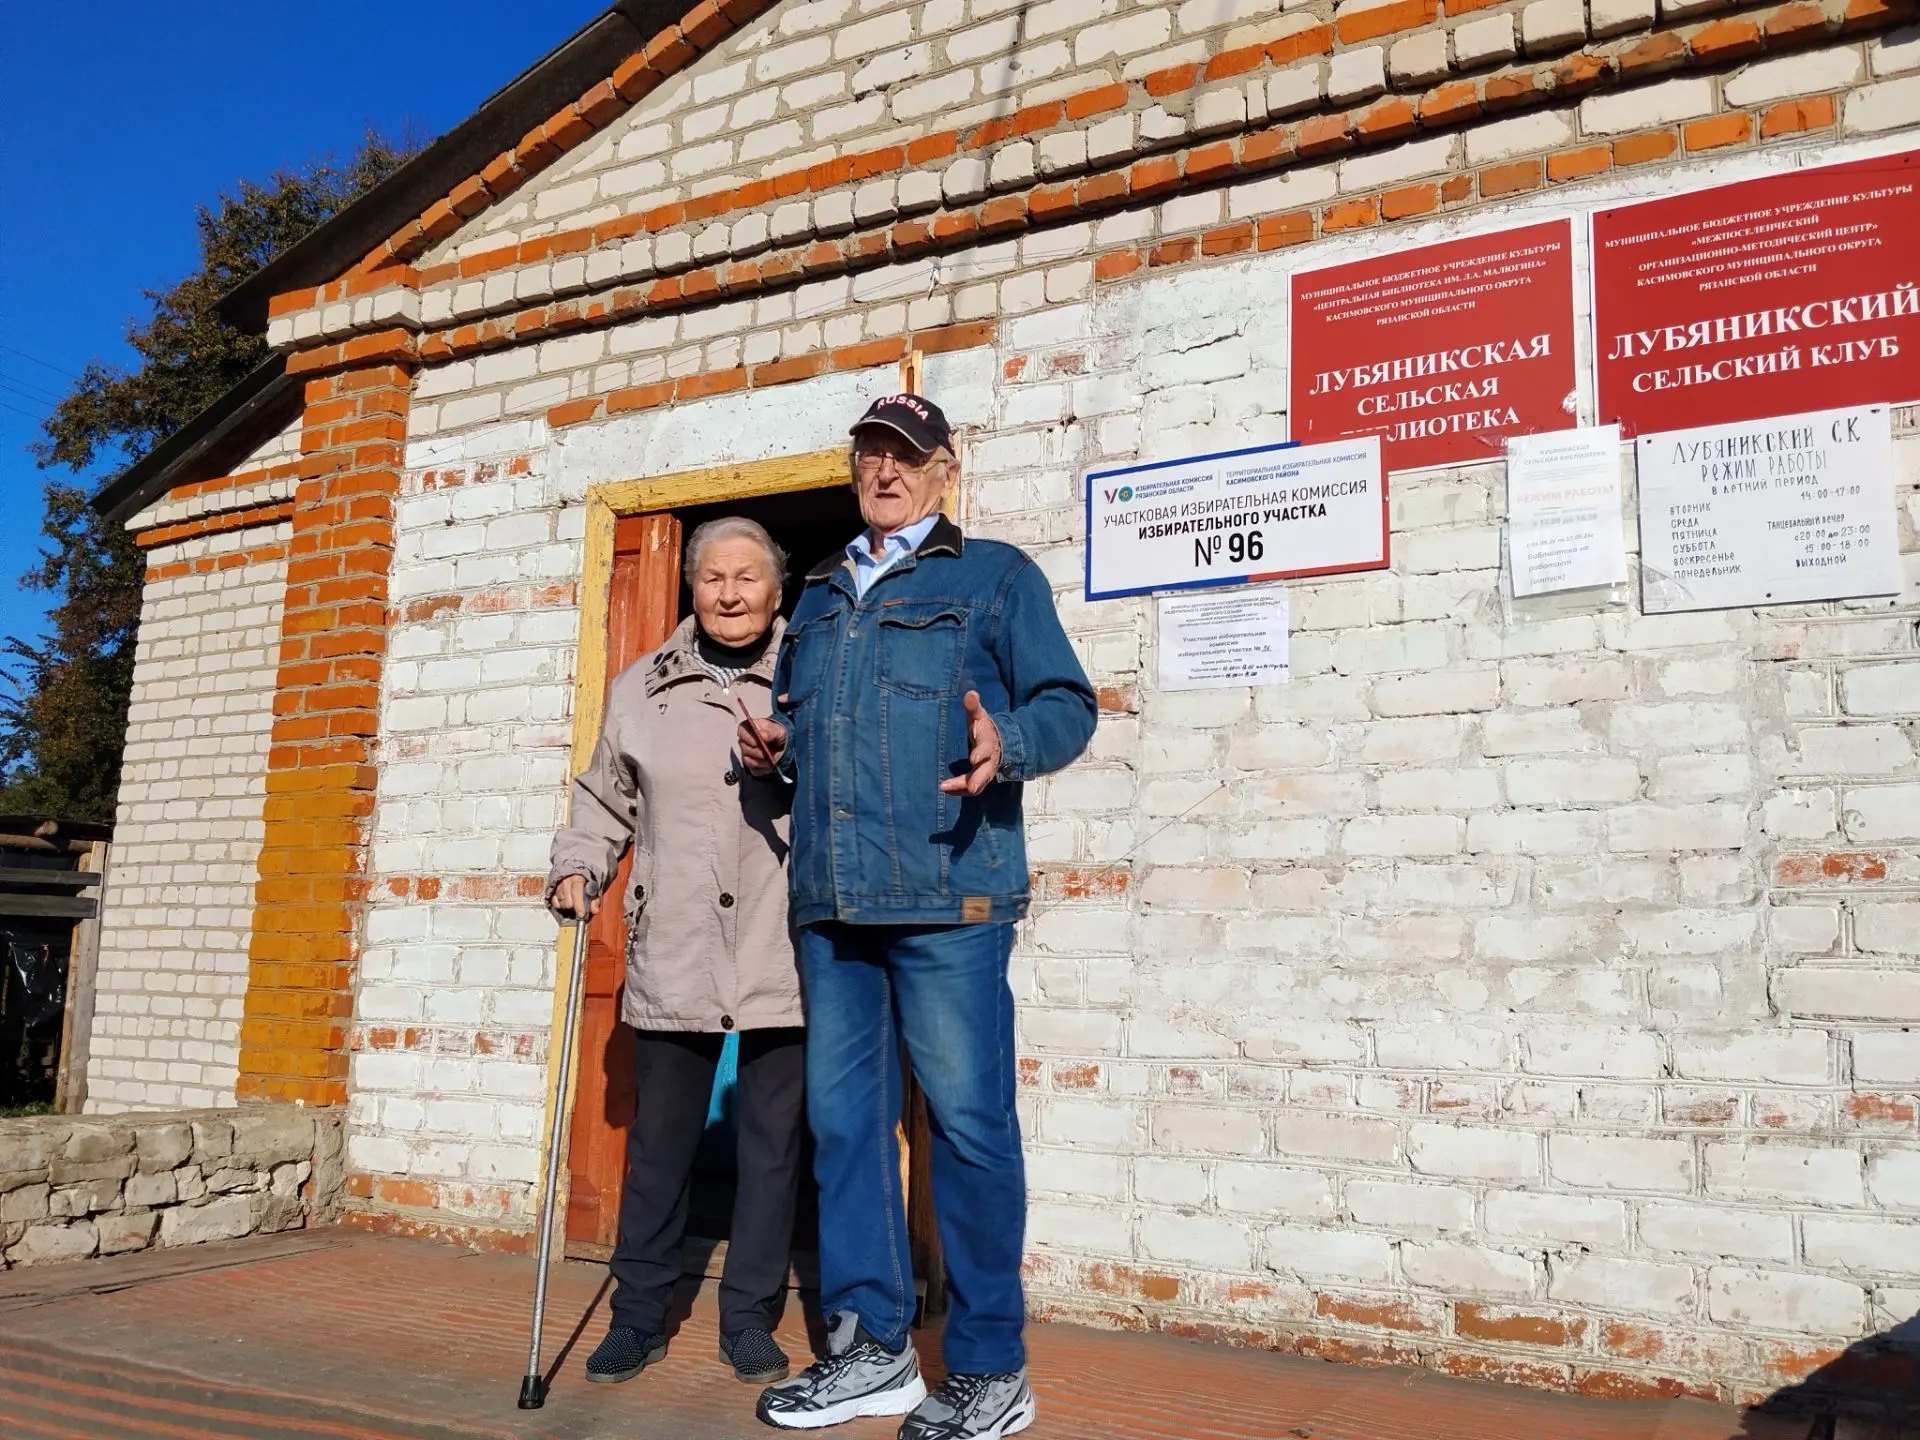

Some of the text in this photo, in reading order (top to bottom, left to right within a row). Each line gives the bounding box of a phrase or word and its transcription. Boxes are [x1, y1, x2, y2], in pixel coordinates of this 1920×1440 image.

[1605, 184, 1912, 248] МУНИЦИПАЛЬНОЕ БЮДЖЕТНОЕ УЧРЕЖДЕНИЕ КУЛЬТУРЫ
[1691, 214, 1819, 246] «МЕЖПОСЕЛЕНЧЕСКИЙ
[1637, 237, 1883, 287] КАСИМОВСКОГО МУНИЦИПАЛЬНОГО ОКРУГА
[1638, 223, 1879, 272] ОРГАНИЗАЦИОННО-МЕТОДИЧЕСКИЙ ЦЕНТР»
[1301, 242, 1561, 300] МУНИЦИПАЛЬНОЕ БЮДЖЕТНОЕ УЧРЕЖДЕНИЕ КУЛЬТУРЫ
[1699, 263, 1817, 292] РЯЗАНСКОЙ ОБЛАСТИ
[1314, 291, 1380, 310] «ЦЕНТРАЛЬНАЯ
[1382, 279, 1442, 297] БИБЛИОТЕКА
[1444, 275, 1461, 285] ИМ.
[1326, 276, 1532, 322] КАСИМОВСКОГО МУНИЦИПАЛЬНОГО ОКРУГА
[1377, 301, 1476, 326] РЯЗАНСКОЙ ОБЛАСТИ
[1608, 281, 1920, 360] ЛУБЯНИКСКИЙ
[1309, 333, 1552, 396] ЛУБЯНИКСКАЯ
[1632, 336, 1899, 393] СЕЛЬСКИЙ КЛУБ
[877, 395, 929, 420] RUSSIA
[1357, 377, 1499, 417] СЕЛЬСКАЯ
[1340, 406, 1520, 442] ЛИОТЕКА
[1671, 425, 1814, 465] ЛУБЯНИКСКИЙ
[1226, 452, 1367, 479] ТЕРРИТОРИАЛЬНАЯ ИЗБИРАТЕЛЬНАЯ КОМИССИЯ
[1226, 470, 1299, 486] КАСИМОВСКОГО РАЙОНА
[1769, 450, 1827, 476] РАБОТЫ
[1136, 474, 1213, 491] ИЗБИРАТЕЛЬНАЯ КОМИССИЯ
[1136, 485, 1194, 500] РЯЗАНСКОЙ ОБЛАСТИ
[1517, 491, 1561, 504] РЕЖИМ
[1104, 479, 1367, 528] УЧАСТКОВАЯ ИЗБИРАТЕЛЬНАЯ КОМИССИЯ
[1670, 502, 1712, 516] ВТОРНИК
[1139, 503, 1327, 540] ИЗБИРАТЕЛЬНОГО УЧАСТКА
[1672, 528, 1718, 541] ПЯТНИЦА
[1194, 531, 1264, 567] № 96
[1527, 547, 1578, 560] Библиотека
[1673, 541, 1716, 555] СУББОТА
[1796, 553, 1847, 568] ВЫХОДНОЙ
